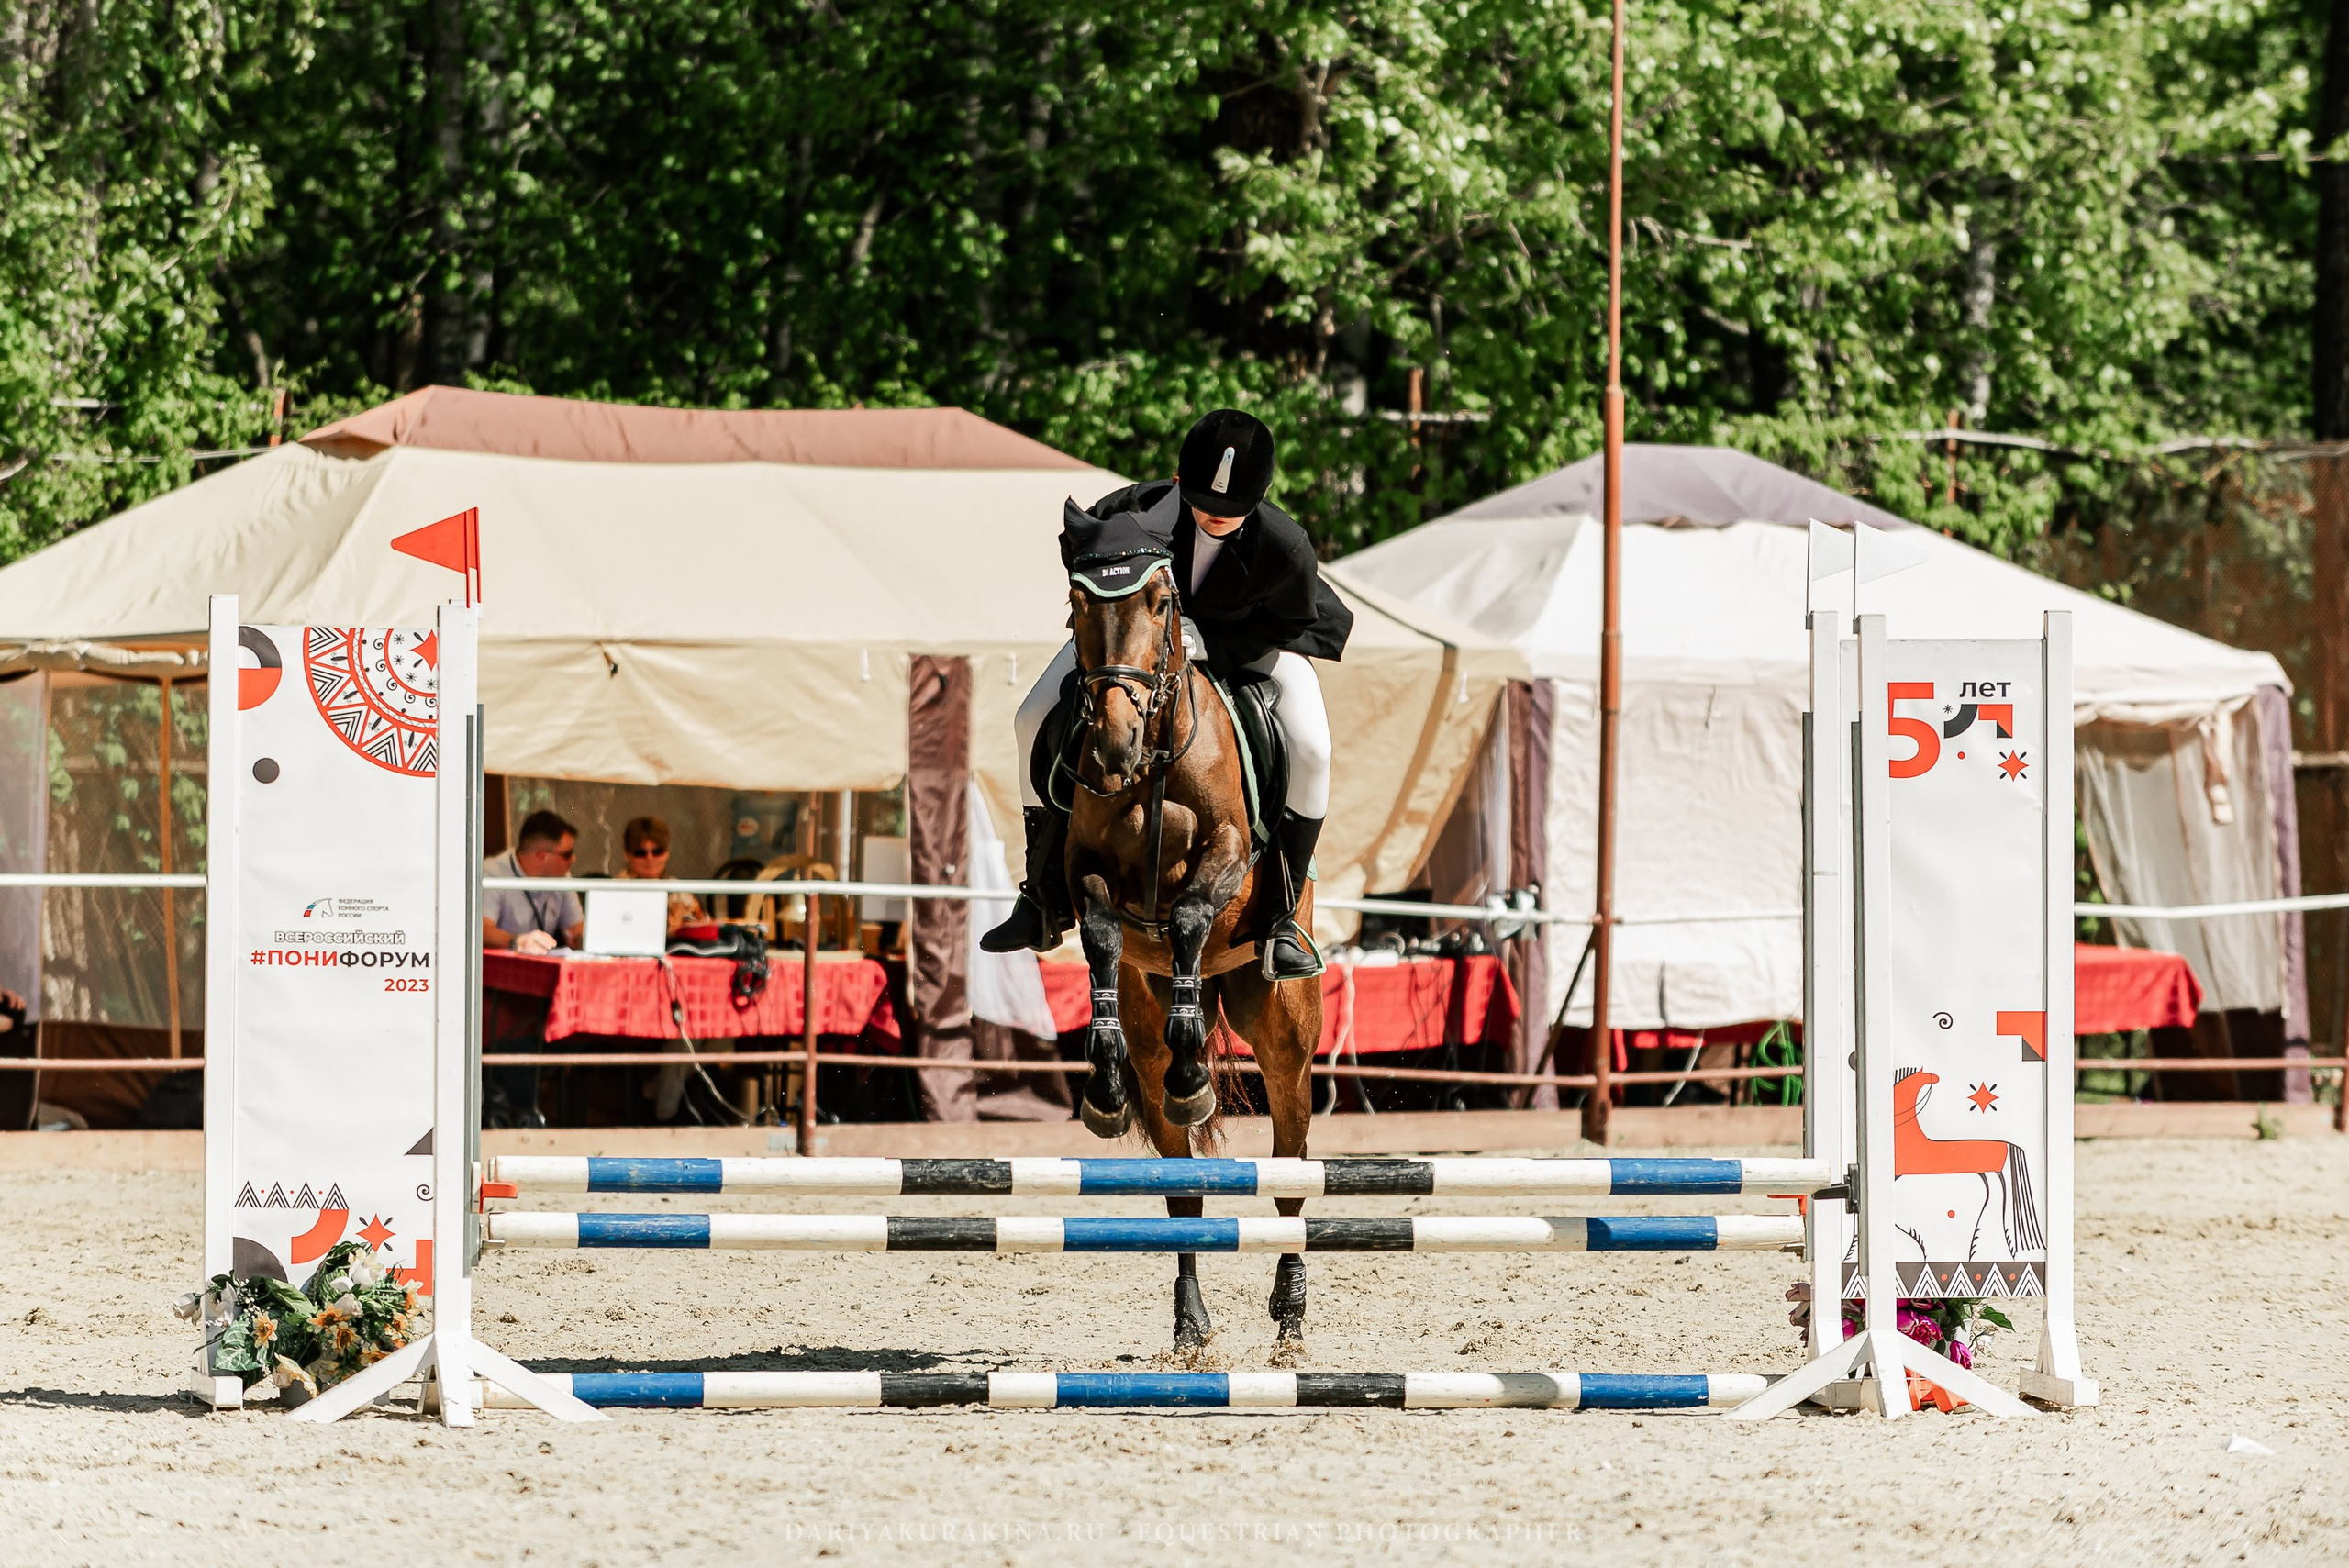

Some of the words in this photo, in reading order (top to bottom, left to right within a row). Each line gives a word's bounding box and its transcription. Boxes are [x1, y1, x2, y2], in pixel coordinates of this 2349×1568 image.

[1887, 682, 1941, 779] 5
[1959, 682, 2012, 698] лет
[274, 929, 406, 945] ВСЕРОССИЙСКИЙ
[250, 950, 430, 968] #ПОНИФОРУМ
[384, 978, 429, 993] 2023
